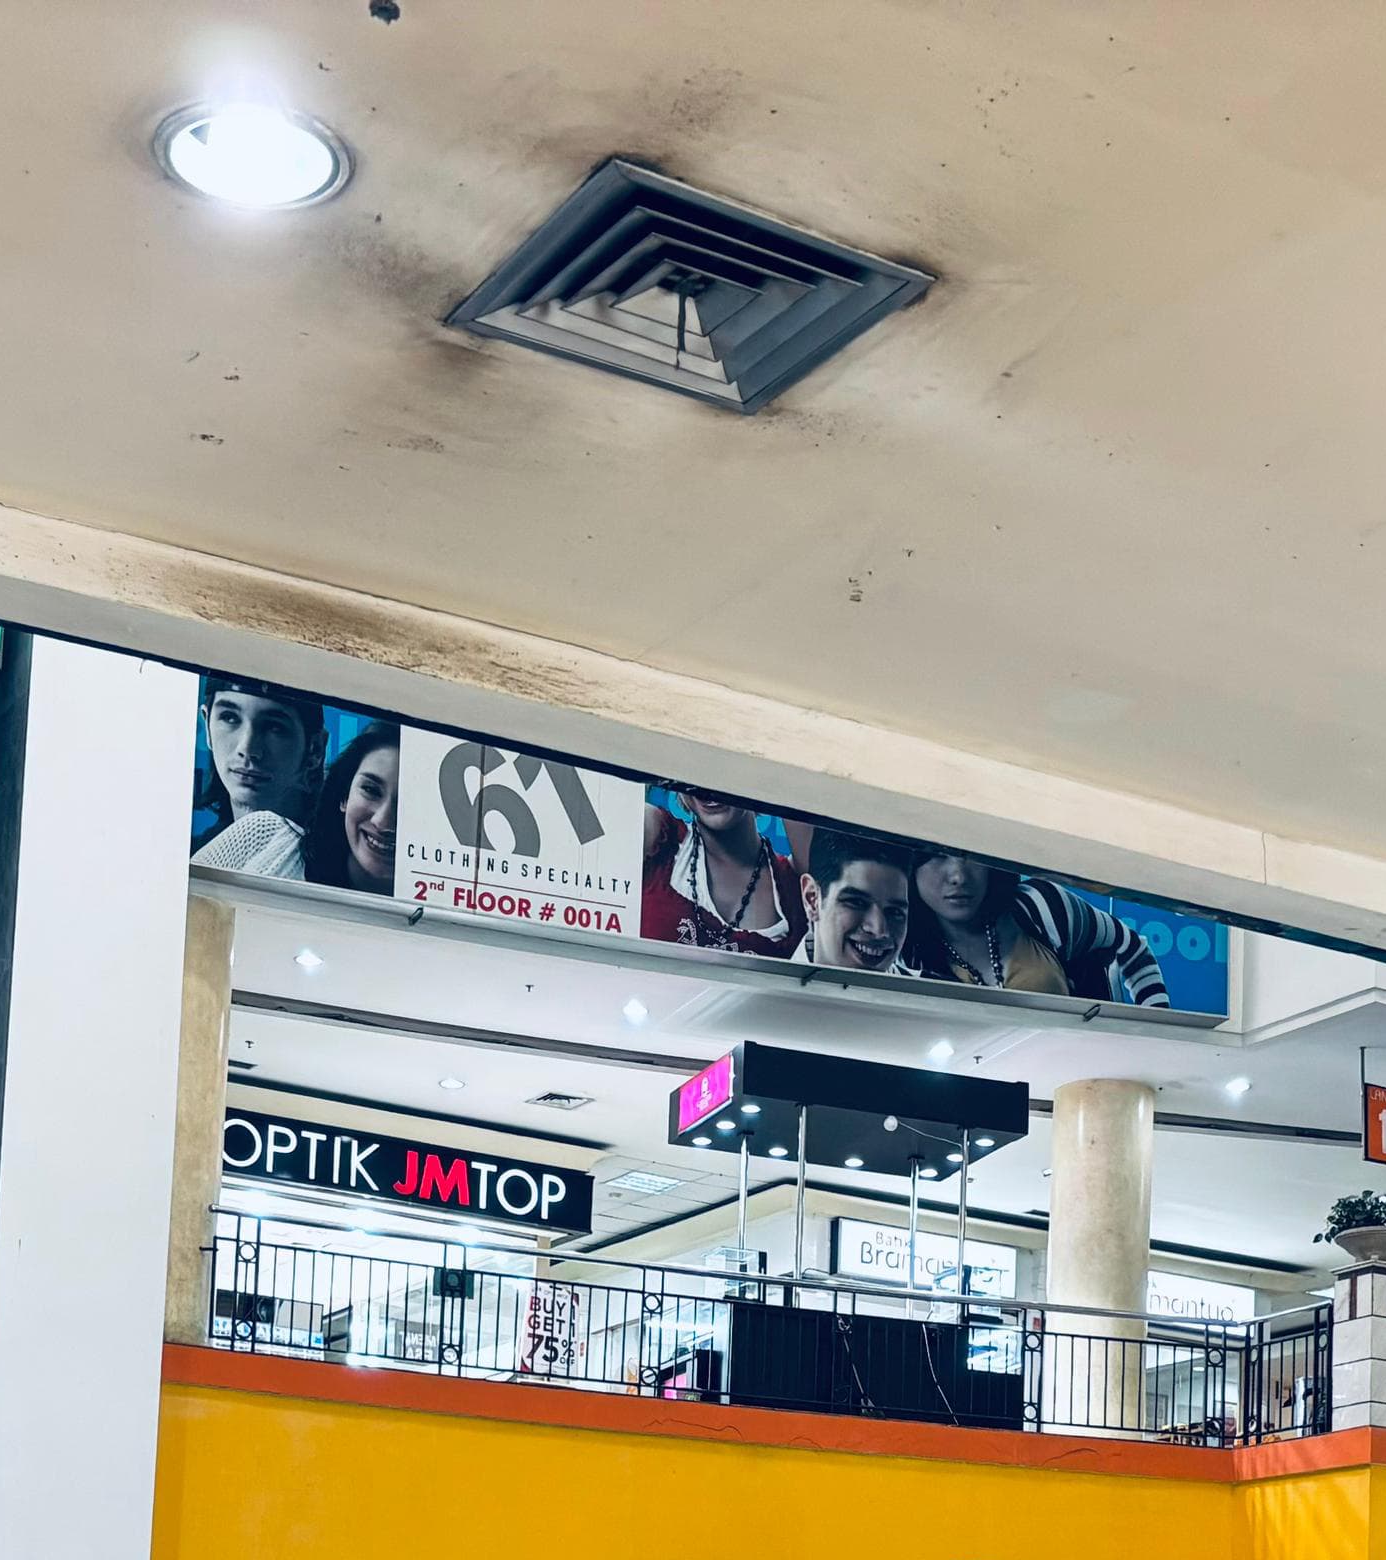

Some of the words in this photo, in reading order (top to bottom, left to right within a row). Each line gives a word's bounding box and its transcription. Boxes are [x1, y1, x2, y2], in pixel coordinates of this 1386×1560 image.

[521, 863, 631, 895] SPECIALTY
[414, 880, 444, 901] 2nd
[453, 886, 532, 918] FLOOR
[539, 902, 556, 921] #
[564, 906, 622, 933] 001A
[222, 1118, 380, 1191] OPTIK
[530, 1296, 566, 1317] BUY
[527, 1314, 565, 1335] GET
